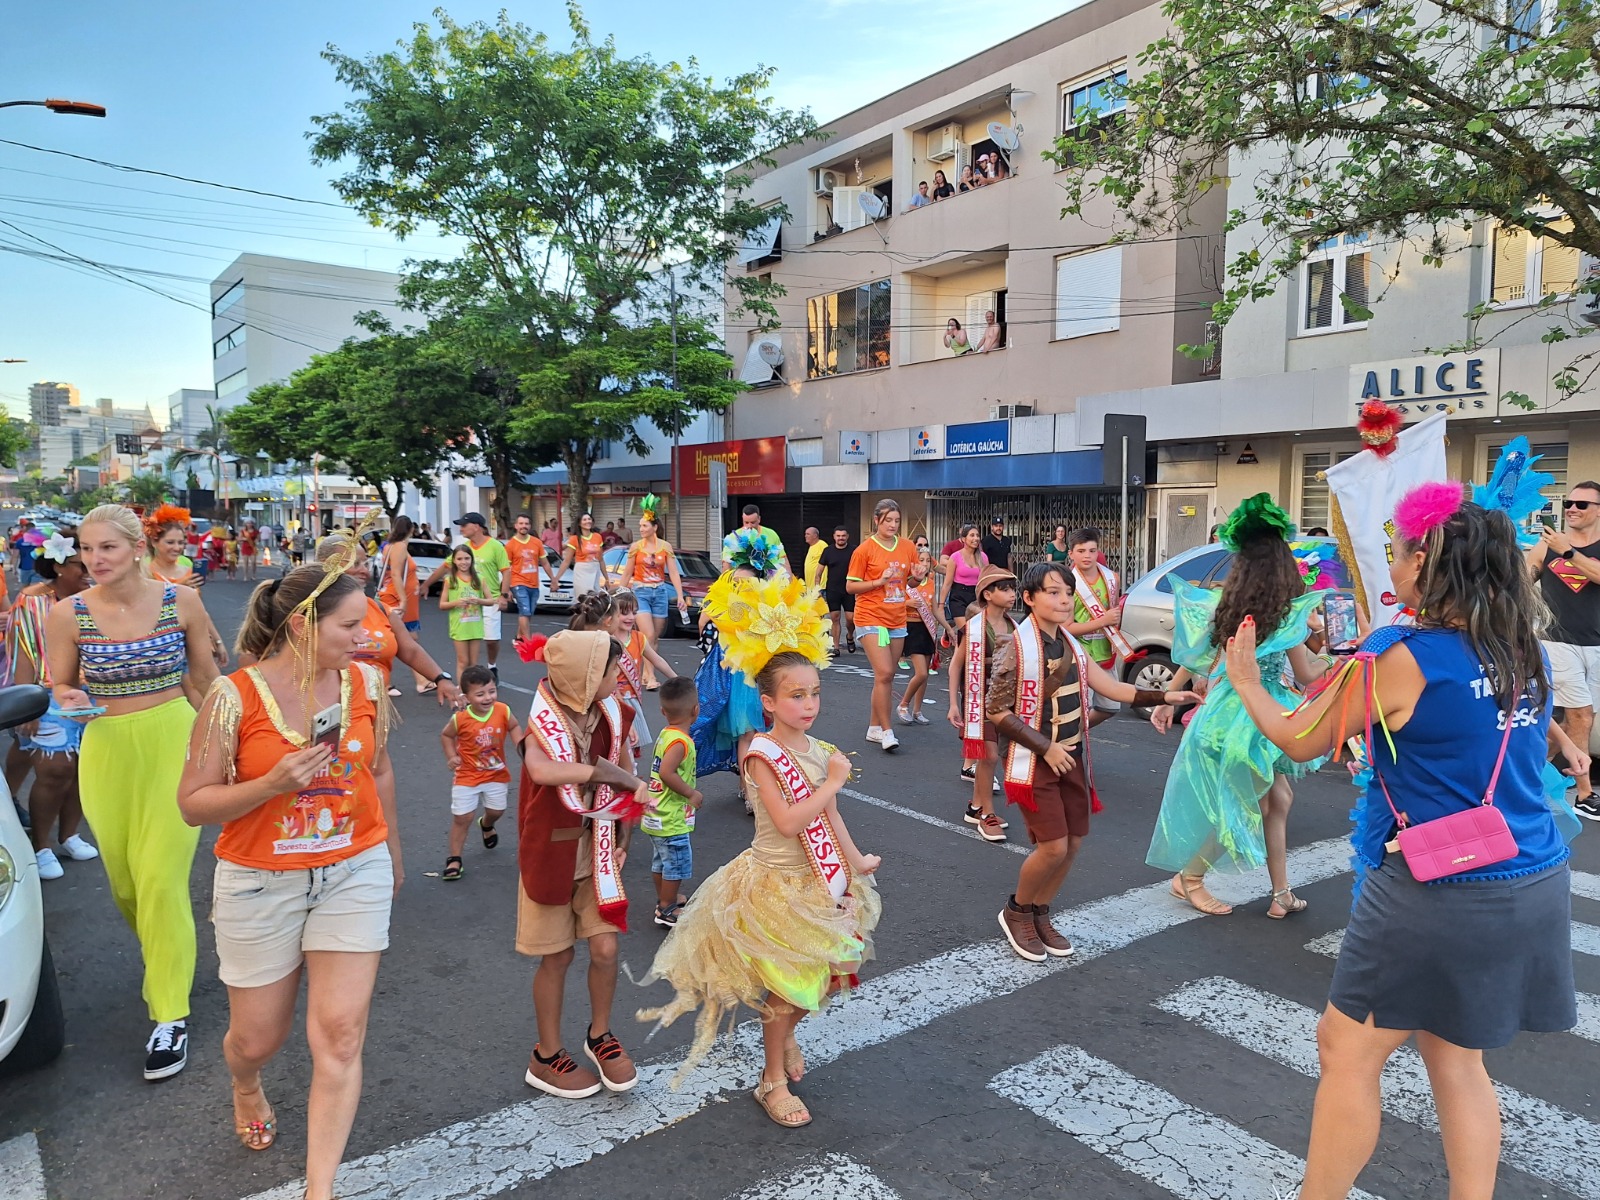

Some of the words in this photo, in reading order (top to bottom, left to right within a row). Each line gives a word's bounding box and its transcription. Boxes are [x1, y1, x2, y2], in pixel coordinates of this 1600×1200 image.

[1361, 359, 1483, 398] ALICE
[1358, 399, 1484, 417] ióveis
[950, 440, 977, 454] LOTÉRICA
[977, 438, 1004, 452] GAÚCHA
[1090, 604, 1115, 636] RI
[968, 641, 981, 723] PRÍNCIPE
[310, 777, 340, 787] nfantil
[315, 763, 344, 777] HO
[773, 752, 841, 884] PRINESA
[599, 825, 611, 876] 2024
